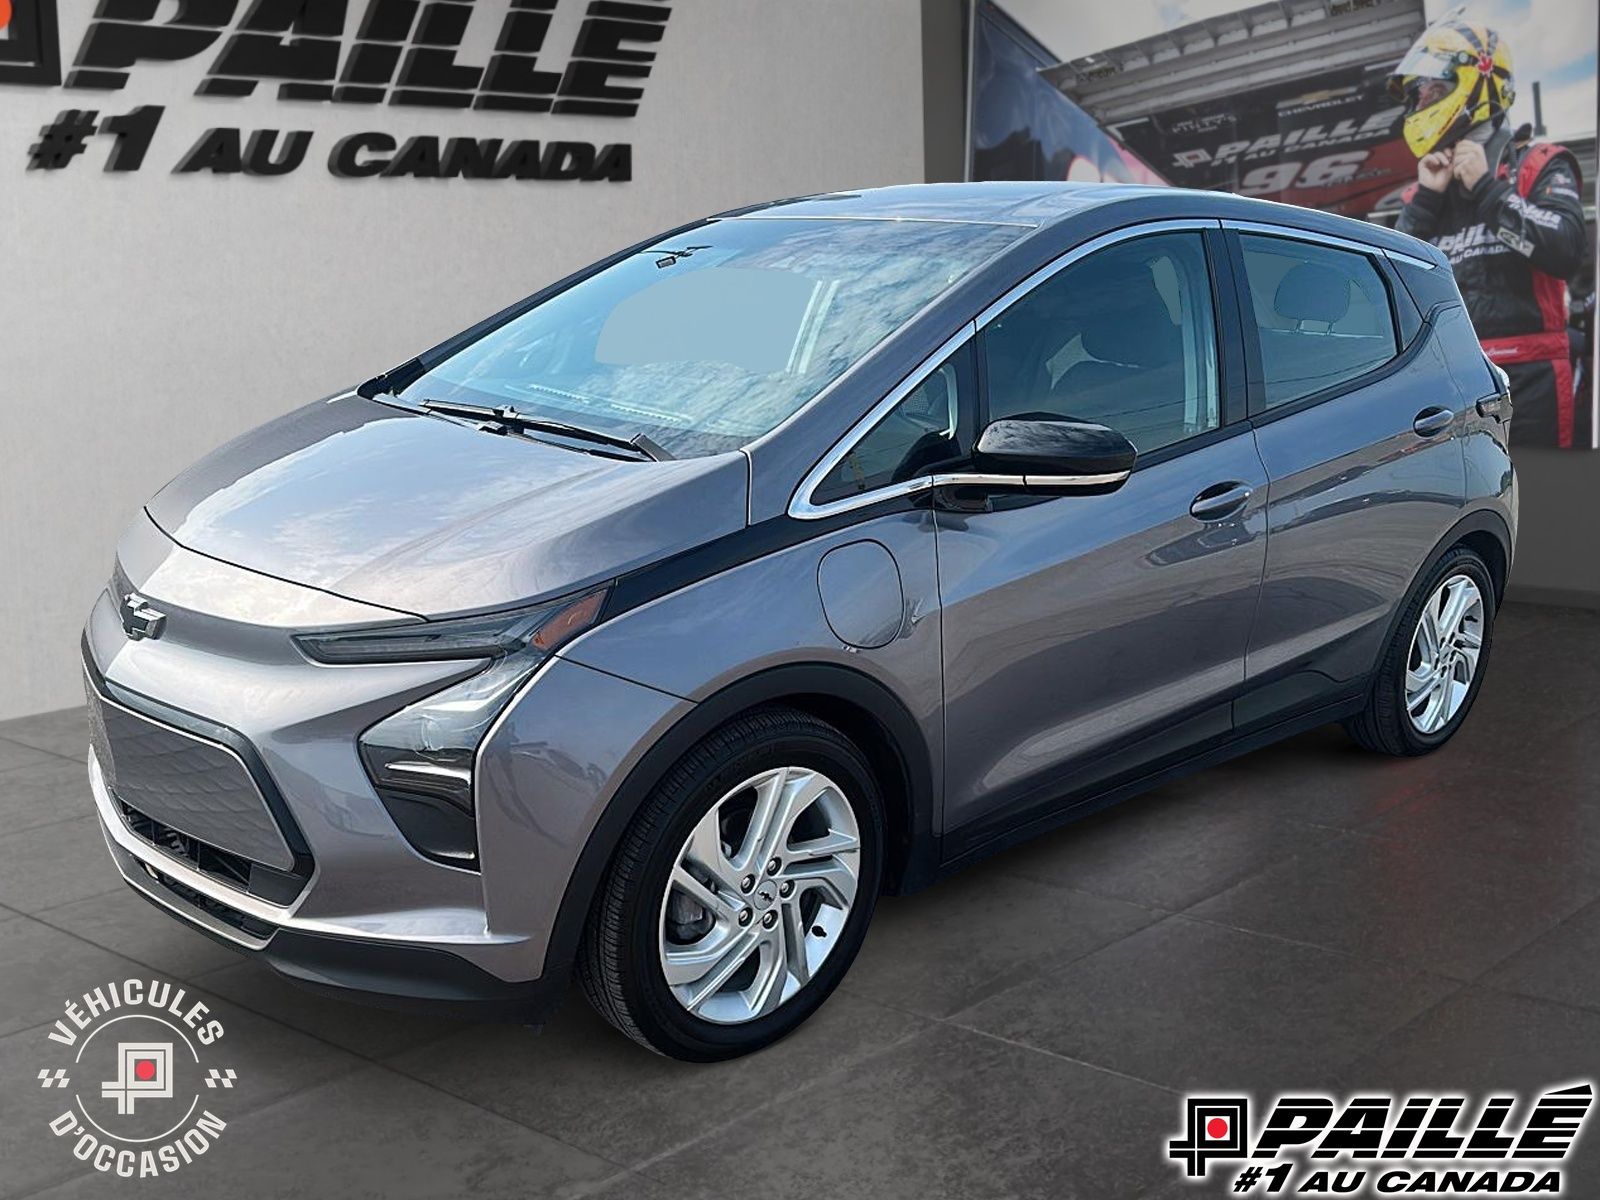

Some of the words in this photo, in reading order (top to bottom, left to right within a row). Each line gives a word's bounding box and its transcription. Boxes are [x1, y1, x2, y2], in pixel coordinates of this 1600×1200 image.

[26, 105, 166, 172] #1
[170, 128, 314, 176] AU
[327, 132, 632, 182] CANADA
[1243, 149, 1276, 160] AU
[1284, 128, 1390, 153] CANADA
[1239, 151, 1370, 196] 96
